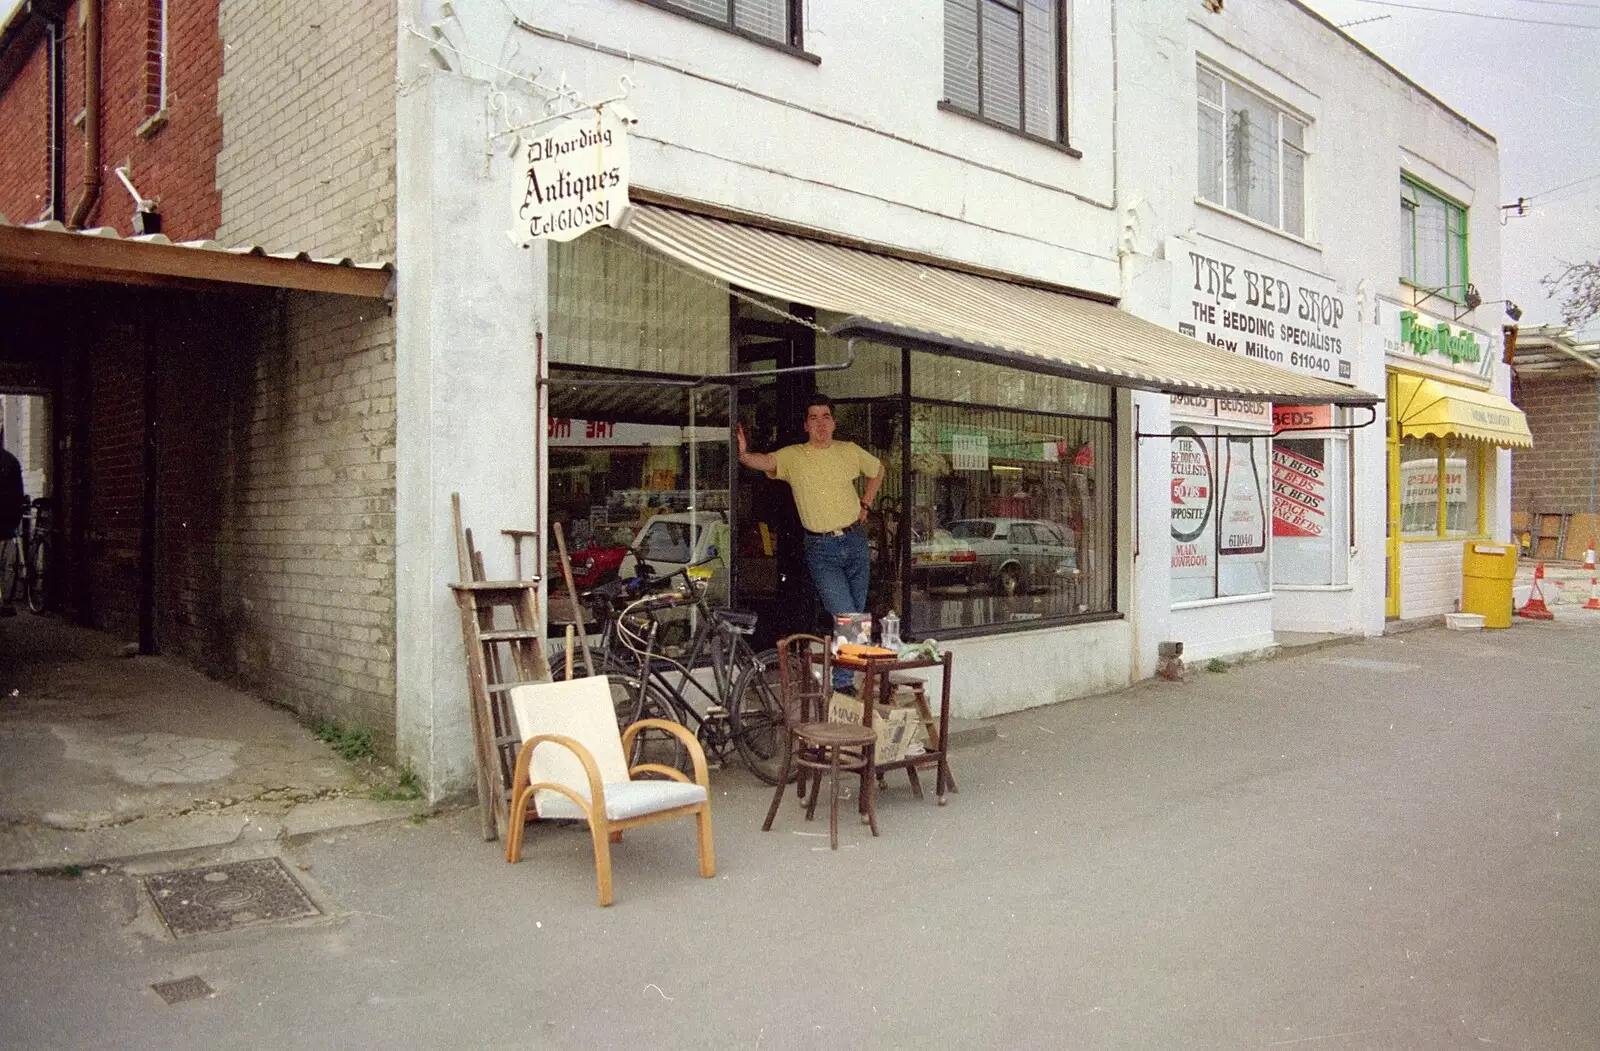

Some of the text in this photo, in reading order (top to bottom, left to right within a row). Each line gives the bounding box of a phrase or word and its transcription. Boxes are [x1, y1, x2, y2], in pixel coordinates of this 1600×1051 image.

[520, 167, 620, 220] Antiques
[1189, 252, 1236, 304] THE
[1243, 270, 1291, 314] BED
[1192, 301, 1342, 355] THE BEDDING SPECIALISTS
[1206, 332, 1330, 372] New Milton 611040
[1272, 411, 1313, 425] BEDS
[1179, 440, 1193, 452] THE
[1171, 452, 1201, 463] BEDDING
[1289, 459, 1320, 478] BEDS
[1284, 472, 1314, 490] BEDS
[1272, 497, 1309, 516] SPACE
[1289, 489, 1320, 507] BEDS
[1292, 516, 1322, 534] BEDS
[1176, 544, 1197, 555] MAIN
[1229, 534, 1253, 547] 611040
